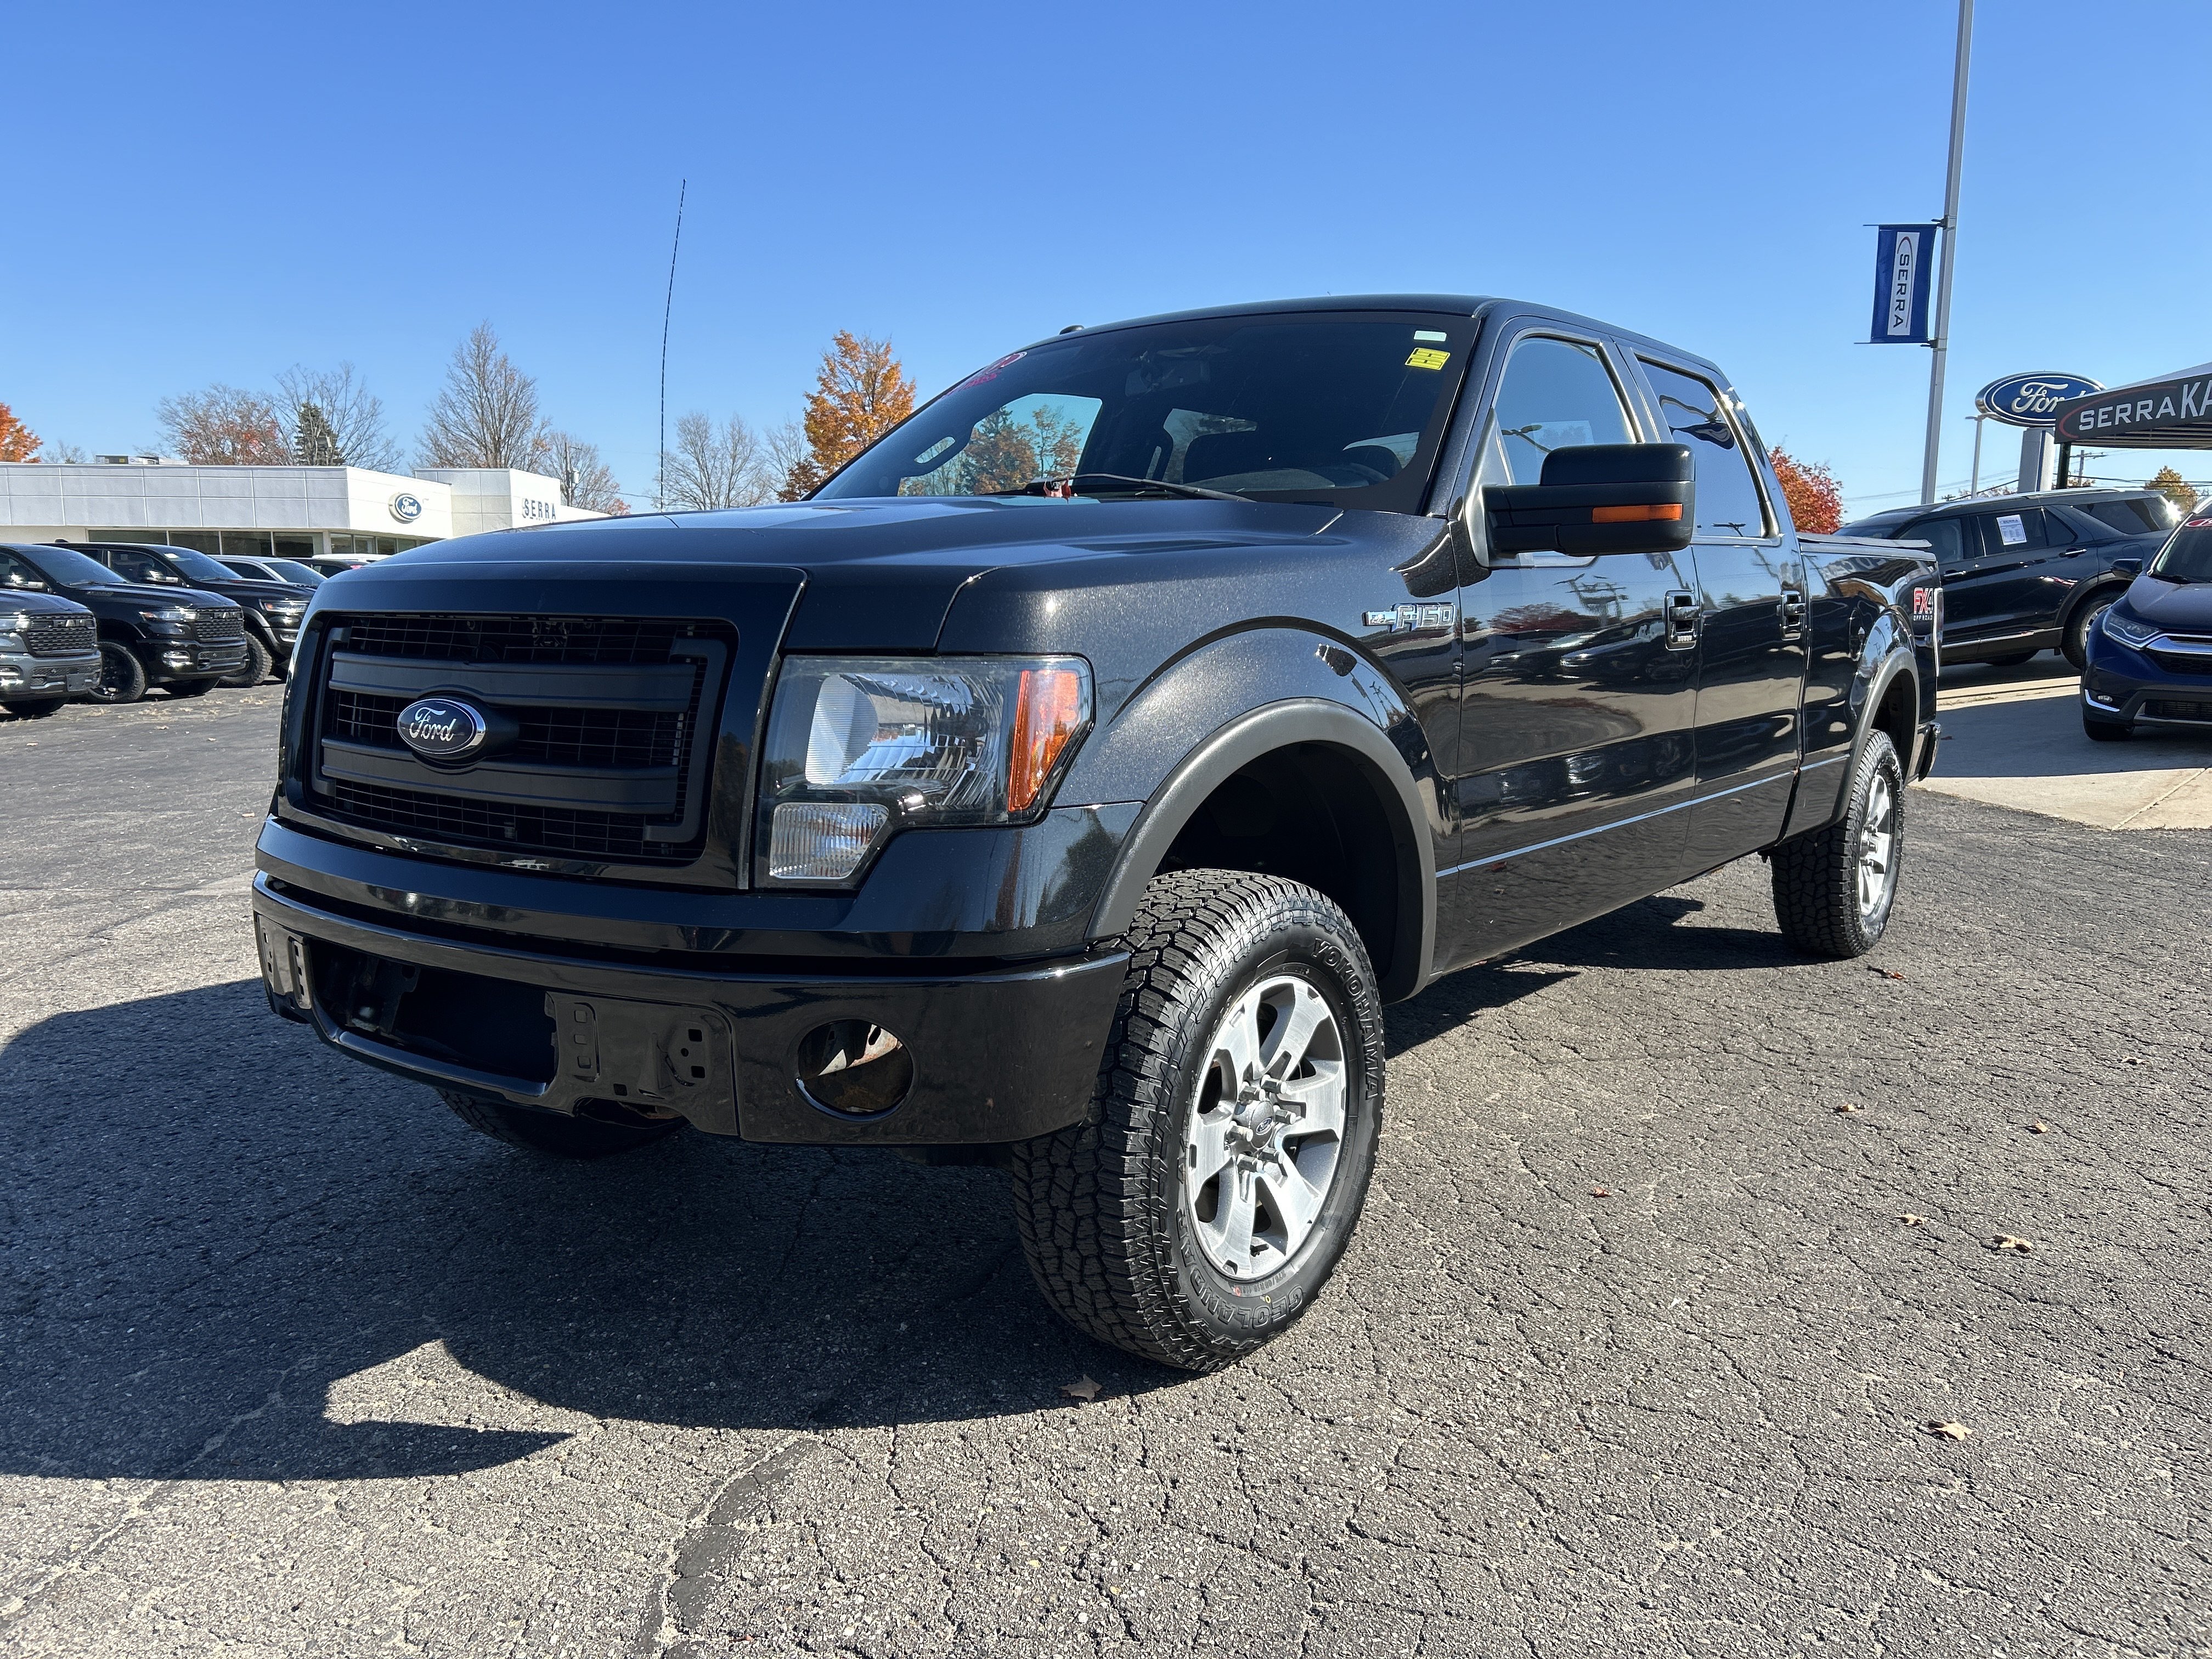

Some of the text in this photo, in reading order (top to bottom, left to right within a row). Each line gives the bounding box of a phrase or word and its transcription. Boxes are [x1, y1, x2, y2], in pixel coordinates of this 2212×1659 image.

[1893, 253, 1910, 329] SERRA
[2011, 382, 2086, 413] For
[2079, 396, 2176, 431] SERRA
[401, 497, 417, 515] Ford
[524, 498, 556, 520] SERRA
[1395, 603, 1455, 630] F-150
[1914, 588, 1933, 614] FX4
[409, 707, 458, 742] Ford
[1312, 938, 1379, 1101] YOKOHAMA
